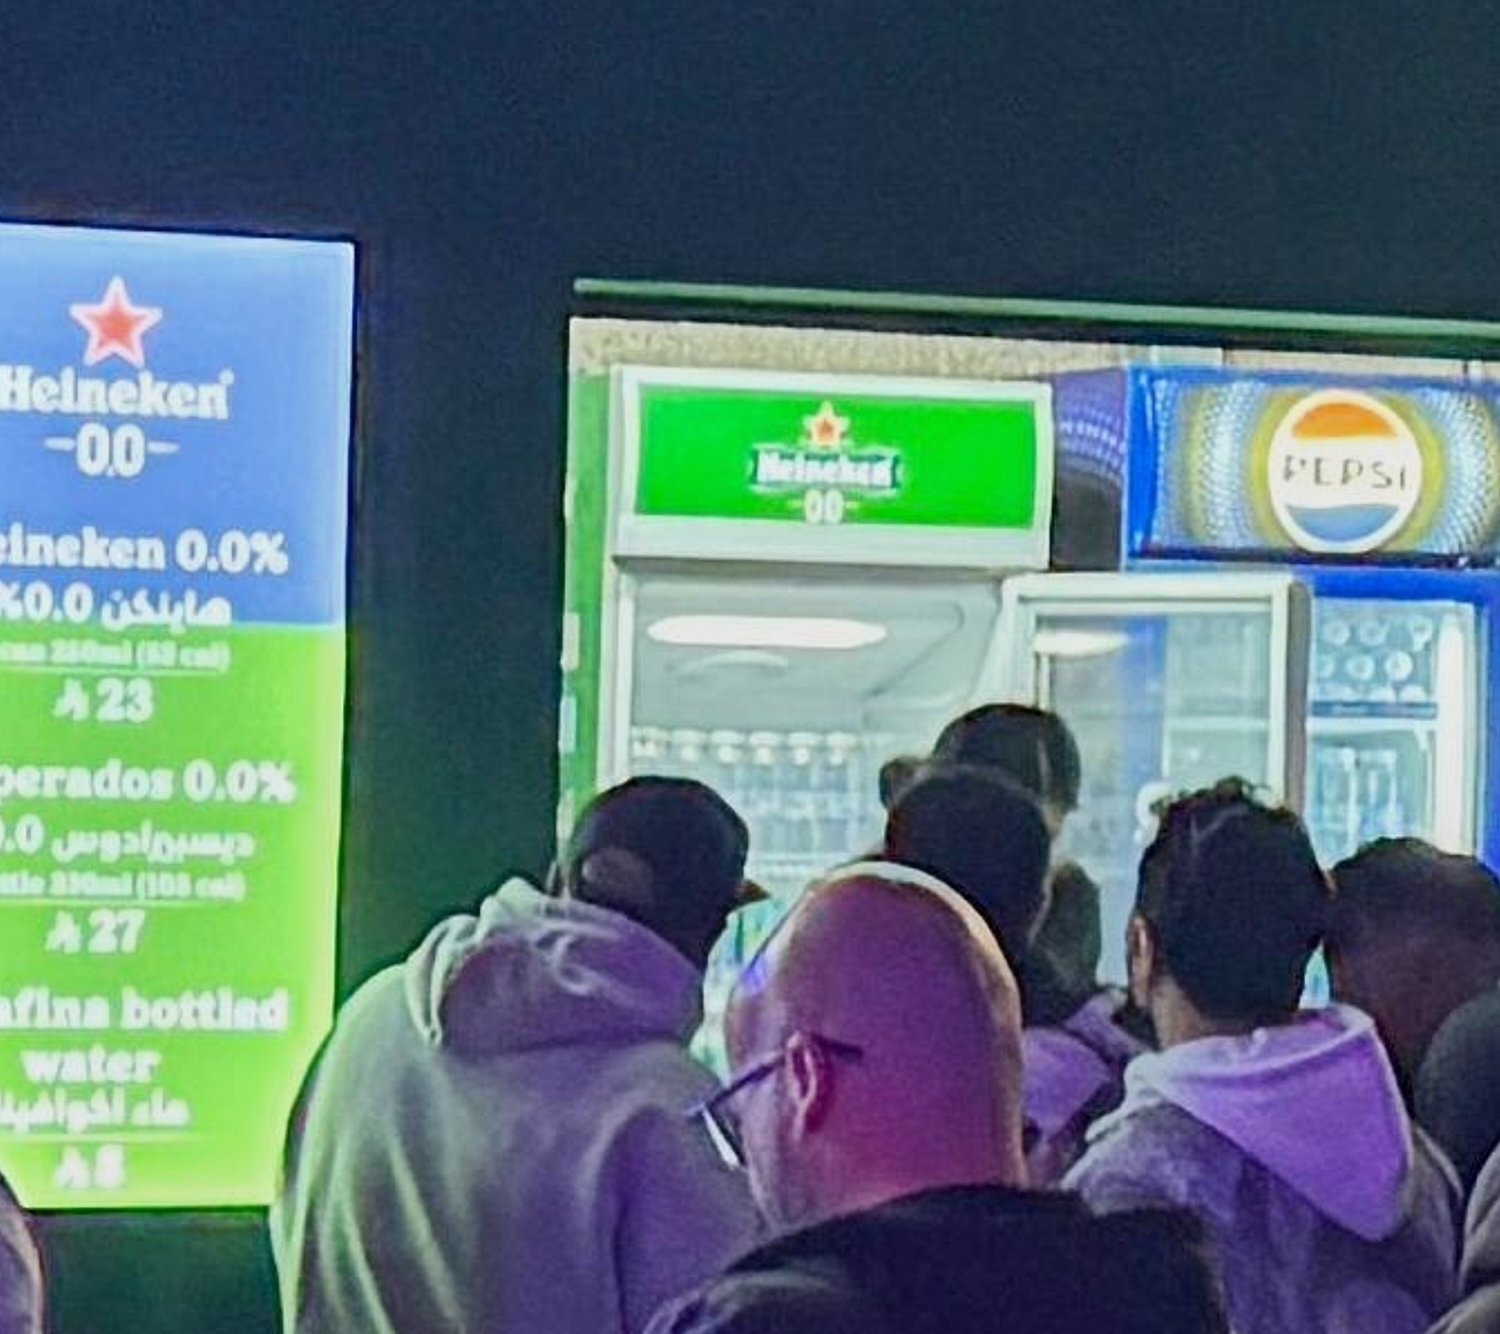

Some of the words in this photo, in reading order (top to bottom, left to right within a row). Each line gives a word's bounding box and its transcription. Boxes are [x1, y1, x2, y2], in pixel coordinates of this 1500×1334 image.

[1283, 454, 1406, 491] PEPSI
[176, 528, 289, 575] 0.0%
[183, 758, 298, 804] 0.0%
[121, 986, 290, 1031] bottled
[19, 1042, 163, 1085] water
